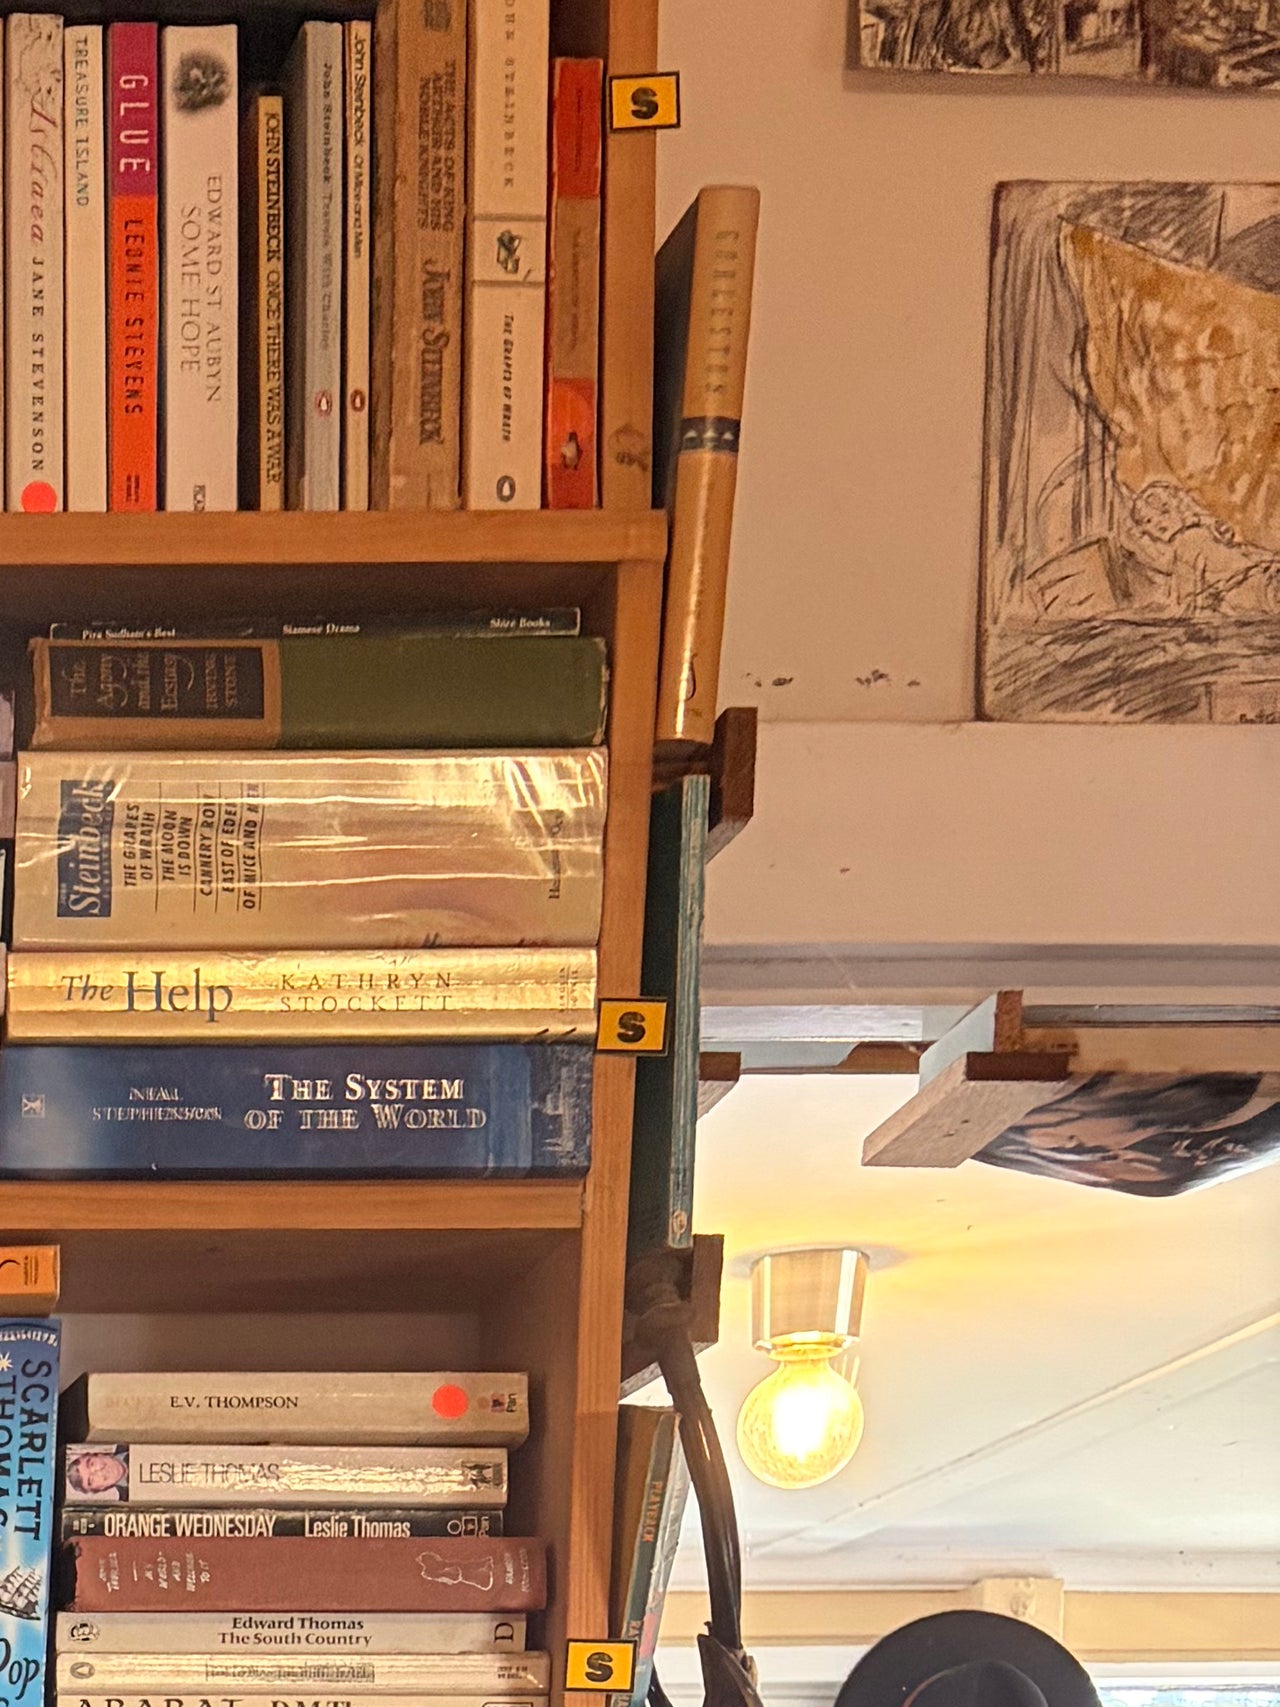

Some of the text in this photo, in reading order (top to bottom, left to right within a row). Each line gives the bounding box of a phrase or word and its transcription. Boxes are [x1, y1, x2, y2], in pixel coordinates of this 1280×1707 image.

[629, 88, 659, 120] S
[616, 1012, 646, 1043] S
[265, 1073, 464, 1101] THE SYSTEM
[206, 1395, 298, 1409] THOMPSON
[19, 1359, 51, 1540] SCARLETT
[586, 1654, 613, 1681] S
